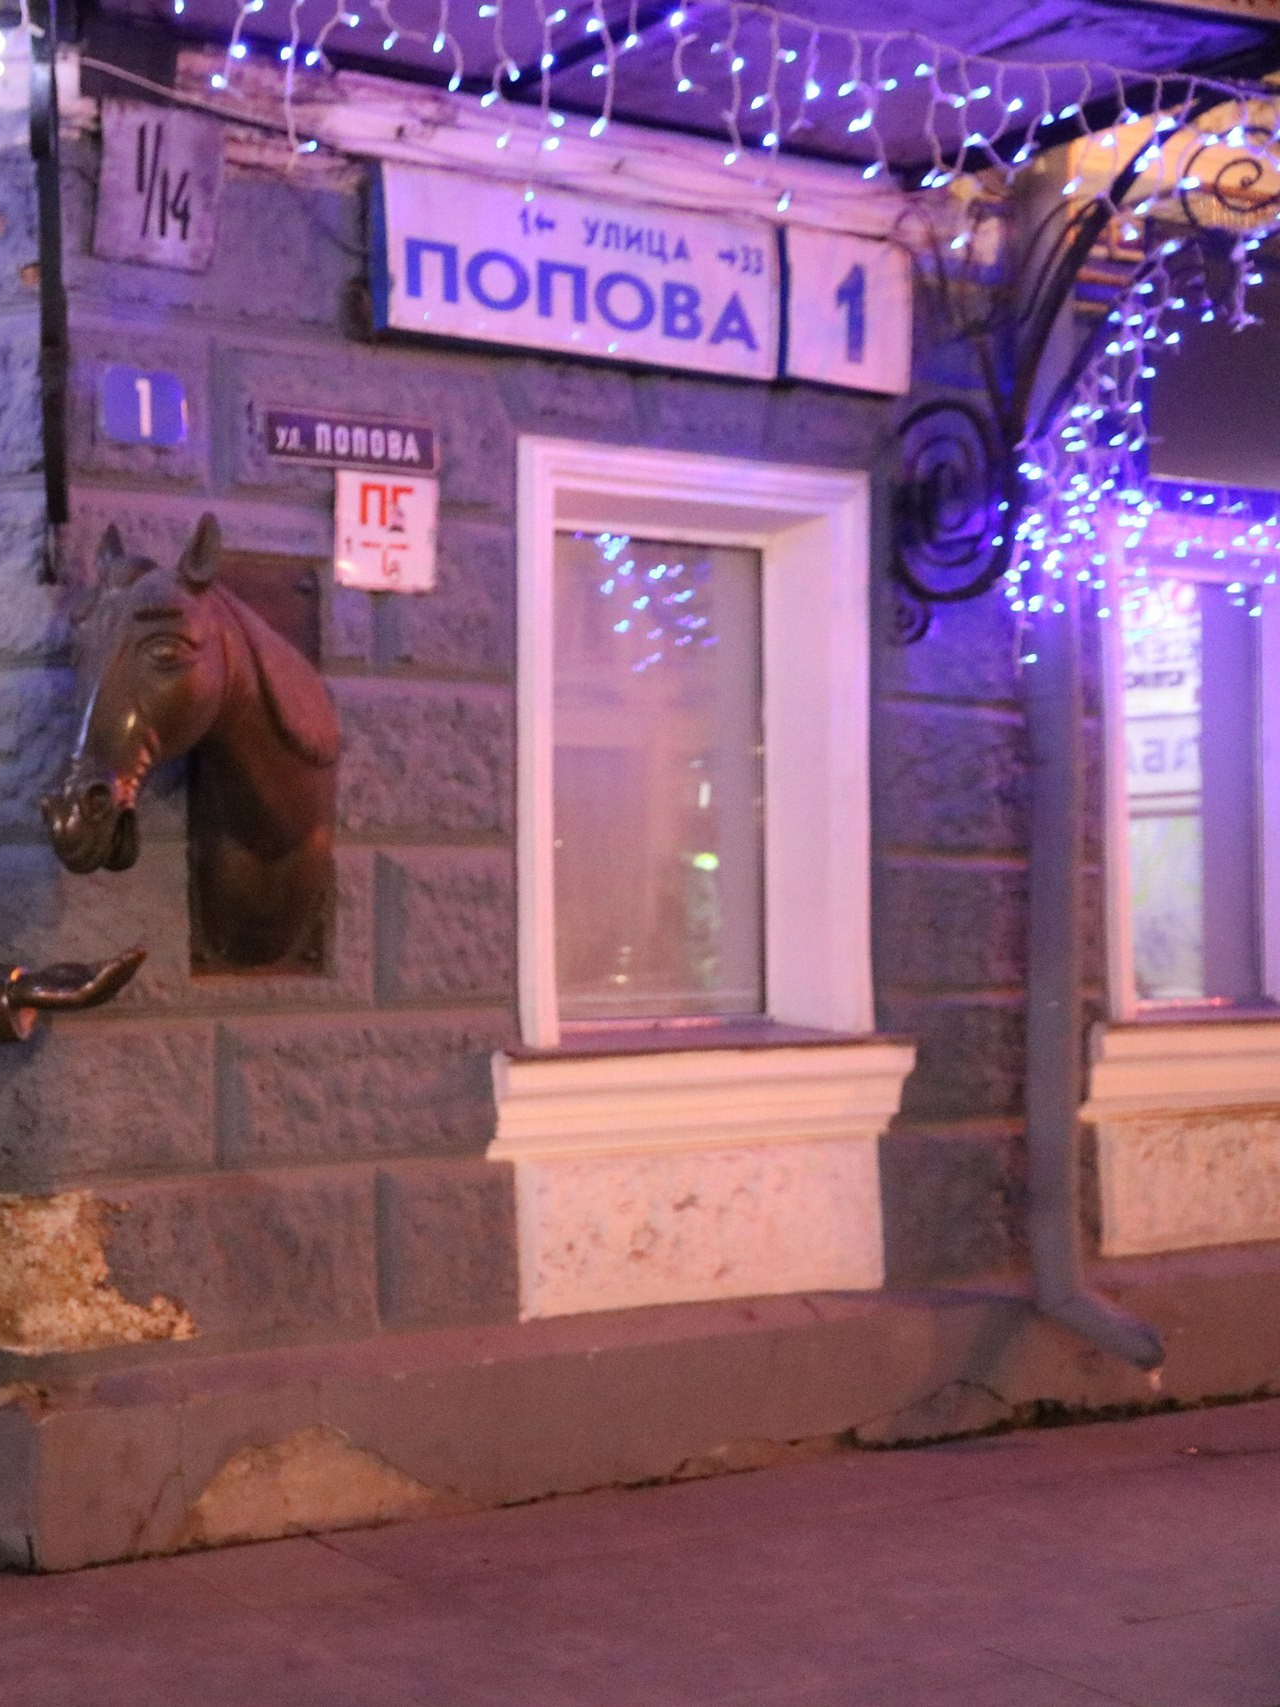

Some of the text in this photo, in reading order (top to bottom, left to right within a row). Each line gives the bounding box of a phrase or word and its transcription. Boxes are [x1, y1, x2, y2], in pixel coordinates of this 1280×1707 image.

[135, 122, 191, 241] 1/14
[519, 207, 530, 236] 1
[583, 216, 691, 265] УЛИЦА
[403, 236, 760, 352] ПОПОВА
[835, 262, 867, 365] 1
[133, 376, 153, 438] 1
[315, 422, 420, 463] ПОПОВА
